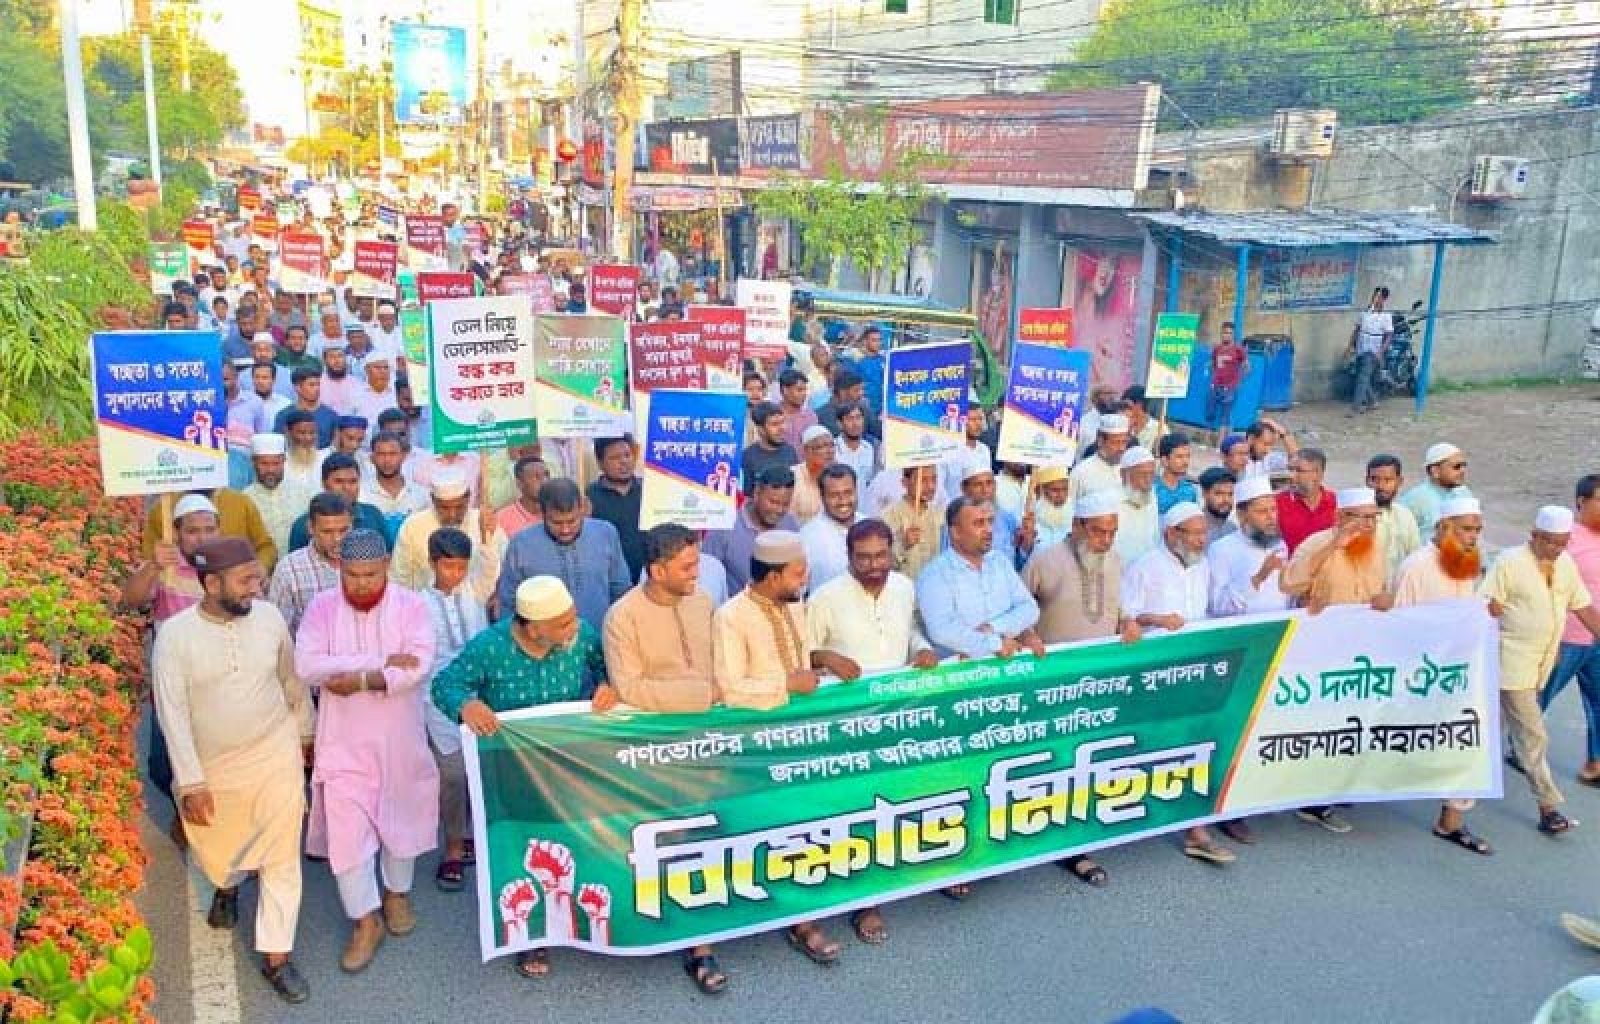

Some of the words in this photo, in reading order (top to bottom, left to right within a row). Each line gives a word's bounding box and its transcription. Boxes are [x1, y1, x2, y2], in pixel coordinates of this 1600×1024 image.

[452, 319, 482, 336] তেল
[485, 312, 517, 333] নিয়ে
[107, 362, 149, 383] স্বচ্ছতা
[153, 364, 165, 379] ও
[458, 364, 485, 379] বন্ধ
[488, 361, 515, 376] কর
[104, 391, 164, 415] সুশাসনের
[168, 391, 188, 416] মূল
[191, 388, 216, 407] কথা
[449, 385, 494, 401] করতে
[496, 382, 525, 397] হবে
[659, 416, 690, 434] স্বচ্ছতা
[693, 418, 701, 432] ও
[653, 441, 697, 461] সুশাসনের
[699, 441, 715, 463] মূল
[717, 441, 737, 458] কথা
[1274, 675, 1312, 705] ১১
[1320, 655, 1396, 702] দলীয়
[1406, 653, 1470, 697] ঐক্য
[616, 732, 744, 770] গণভোটের
[754, 722, 830, 752] গণরায়
[841, 707, 945, 738] বাস্তবায়ন,
[953, 695, 1028, 722] গণতন্ত্র,
[1035, 676, 1133, 706] ন্যায়বিচার,
[1141, 668, 1205, 694] সুশাসন
[1212, 663, 1229, 679] ও
[769, 753, 871, 784] জনগণের
[876, 735, 962, 768] অধিকার
[967, 717, 1047, 753] প্রতিষ্ঠার
[1053, 706, 1118, 736] দাবিতে
[1258, 716, 1363, 766] রাজশাহী
[1369, 708, 1481, 754] মহানগরী
[629, 792, 971, 918] বিক্ষোভ
[984, 735, 1217, 842] মিছিল
